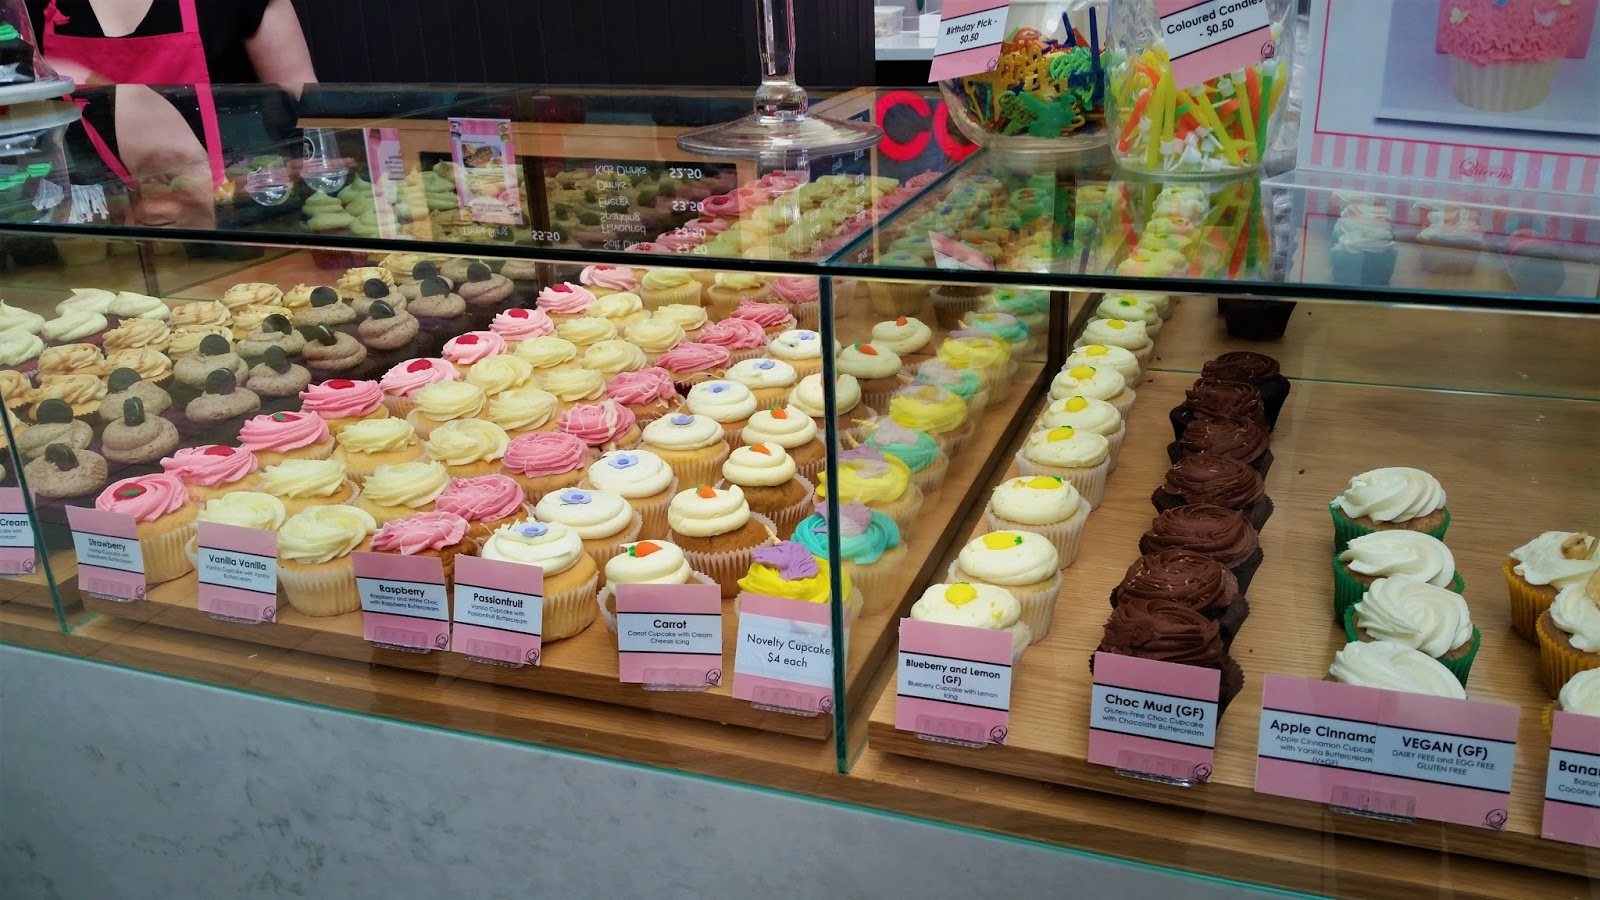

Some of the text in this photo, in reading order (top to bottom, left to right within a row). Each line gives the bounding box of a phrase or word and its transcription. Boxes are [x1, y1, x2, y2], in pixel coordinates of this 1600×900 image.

[946, 21, 976, 36] Birthday
[976, 18, 992, 29] Pick
[1166, 9, 1216, 34] Coloured
[1206, 18, 1234, 37] $0.50
[960, 32, 980, 44] $0.50
[1460, 158, 1513, 180] Queens
[0, 518, 28, 526] Cream
[88, 538, 126, 552] Strawberry
[208, 554, 267, 570] Vanilla Vanilla
[222, 566, 242, 576] Cupcake
[379, 584, 424, 598] Raspberry
[370, 593, 396, 602] Raspberry
[424, 598, 438, 606] Choc
[381, 600, 407, 609] Raspberry
[408, 603, 440, 612] Buttercream
[474, 592, 524, 608] Passionfruit
[468, 610, 528, 624] Passionfruit Buttercream
[471, 604, 488, 612] Vanilla
[489, 606, 513, 616] Cupcake
[653, 620, 688, 629] Carrot
[648, 630, 676, 638] Cupcake
[747, 633, 831, 656] Novelty Cupcake
[767, 652, 808, 668] $4 each
[906, 658, 1001, 679] Blueberry and Lemon
[942, 674, 962, 686] (GF)
[907, 680, 934, 690] Blueberry
[935, 684, 962, 693] Cupcake
[978, 690, 998, 698] Lemon
[944, 692, 958, 700] Icing
[1105, 694, 1204, 720] Choc Mud (GF)
[1102, 714, 1204, 736] with Chocolate Buttercream
[1146, 713, 1168, 723] Choc
[1169, 716, 1204, 729] Cupcake
[1270, 720, 1312, 735] Apple
[1276, 734, 1299, 745] Apple
[1300, 738, 1342, 750] Cinnamon
[1402, 736, 1488, 760] VEGAN (GF)
[1298, 746, 1324, 756] Vanilla
[1325, 750, 1373, 763] Buttercream
[1392, 749, 1496, 770] DAIRY FREE and EGG FREE
[1416, 762, 1468, 776] GLUTEN FREE
[1558, 784, 1596, 796] Coconut
